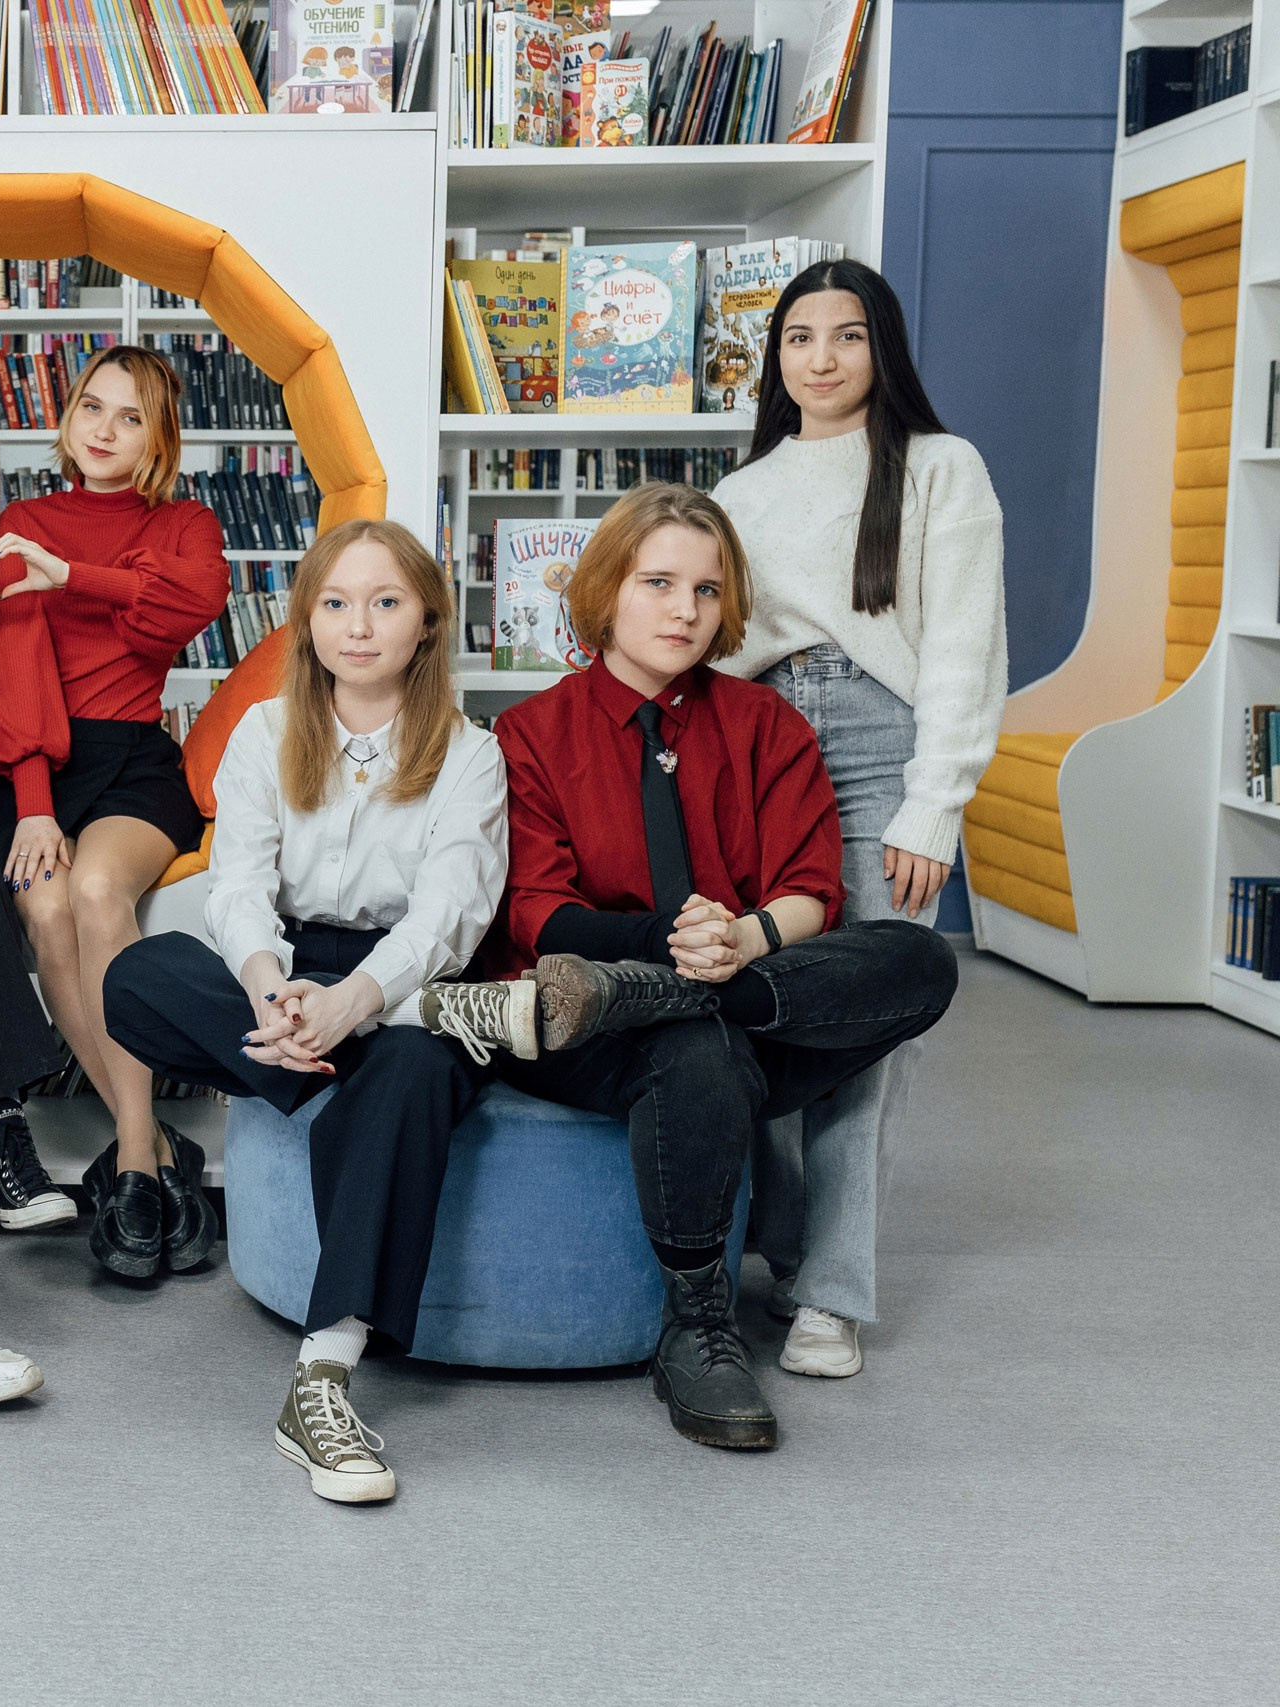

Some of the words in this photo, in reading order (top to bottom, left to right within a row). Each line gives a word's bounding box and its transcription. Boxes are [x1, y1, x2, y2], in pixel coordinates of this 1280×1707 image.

[303, 7, 365, 21] ОБУЧЕНИЕ
[309, 20, 359, 34] ЧТЕНИЮ
[563, 43, 583, 54] НЫЕ
[563, 55, 583, 71] ЛА
[562, 73, 580, 85] ОСТ
[616, 86, 626, 95] 01
[739, 252, 766, 266] КАК
[496, 266, 515, 284] Один
[518, 271, 536, 284] день
[714, 263, 792, 288] ОДЕВАЛСЯ
[604, 280, 656, 298] Цифры
[626, 302, 633, 310] и
[623, 310, 662, 325] счёт
[510, 531, 586, 564] ШНУРК
[505, 581, 519, 592] 20
